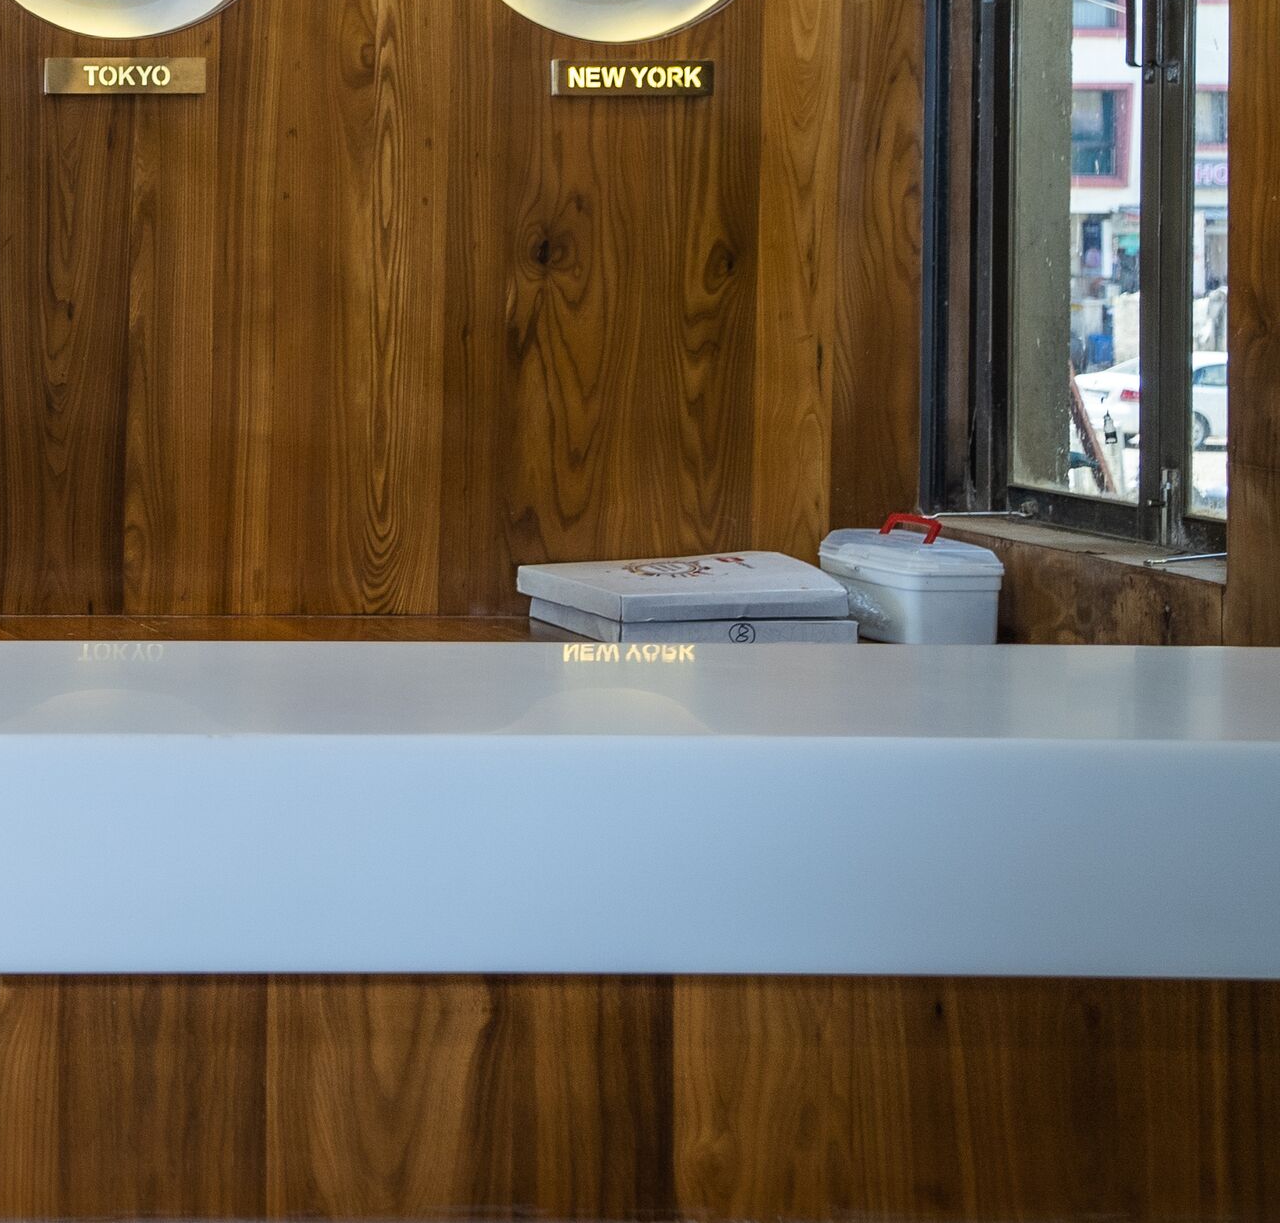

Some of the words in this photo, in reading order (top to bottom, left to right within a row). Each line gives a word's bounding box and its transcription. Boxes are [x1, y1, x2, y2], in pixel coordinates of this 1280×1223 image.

[83, 65, 171, 86] TOKYO
[567, 66, 628, 88] NEW
[630, 66, 702, 88] YORK
